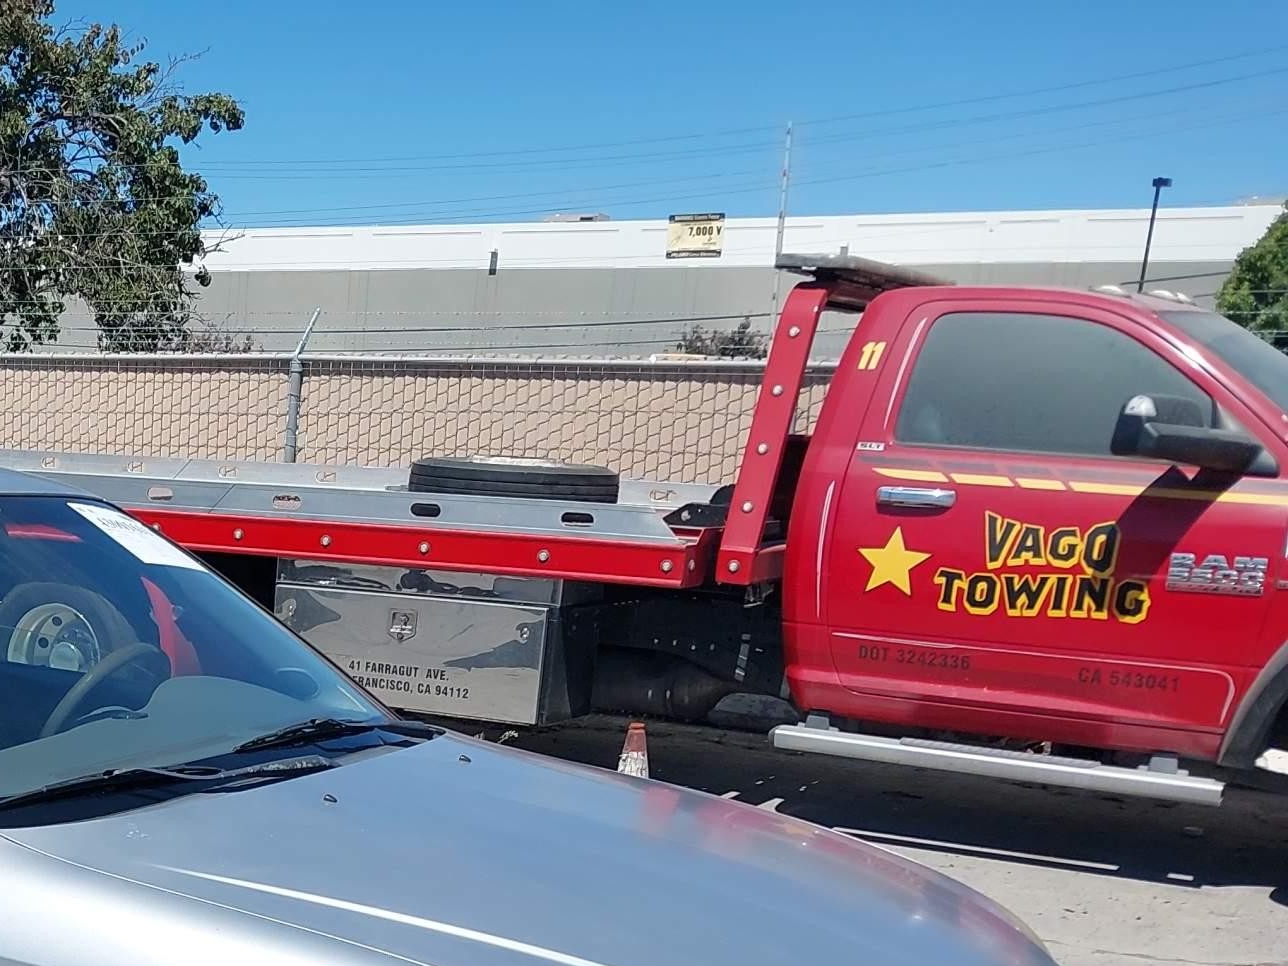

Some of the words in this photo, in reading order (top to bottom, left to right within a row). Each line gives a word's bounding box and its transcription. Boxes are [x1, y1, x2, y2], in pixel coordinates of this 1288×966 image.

[688, 226, 713, 237] 7,000
[857, 341, 887, 370] 11
[984, 510, 1120, 578] VAGO
[934, 567, 1151, 624] TOWING
[859, 645, 889, 661] DOT
[348, 660, 361, 670] 41
[365, 661, 419, 678] FARRAGUT
[426, 668, 449, 681] AVE.
[1079, 668, 1101, 683] CA
[417, 683, 431, 694] CA
[436, 684, 469, 699] 94112
